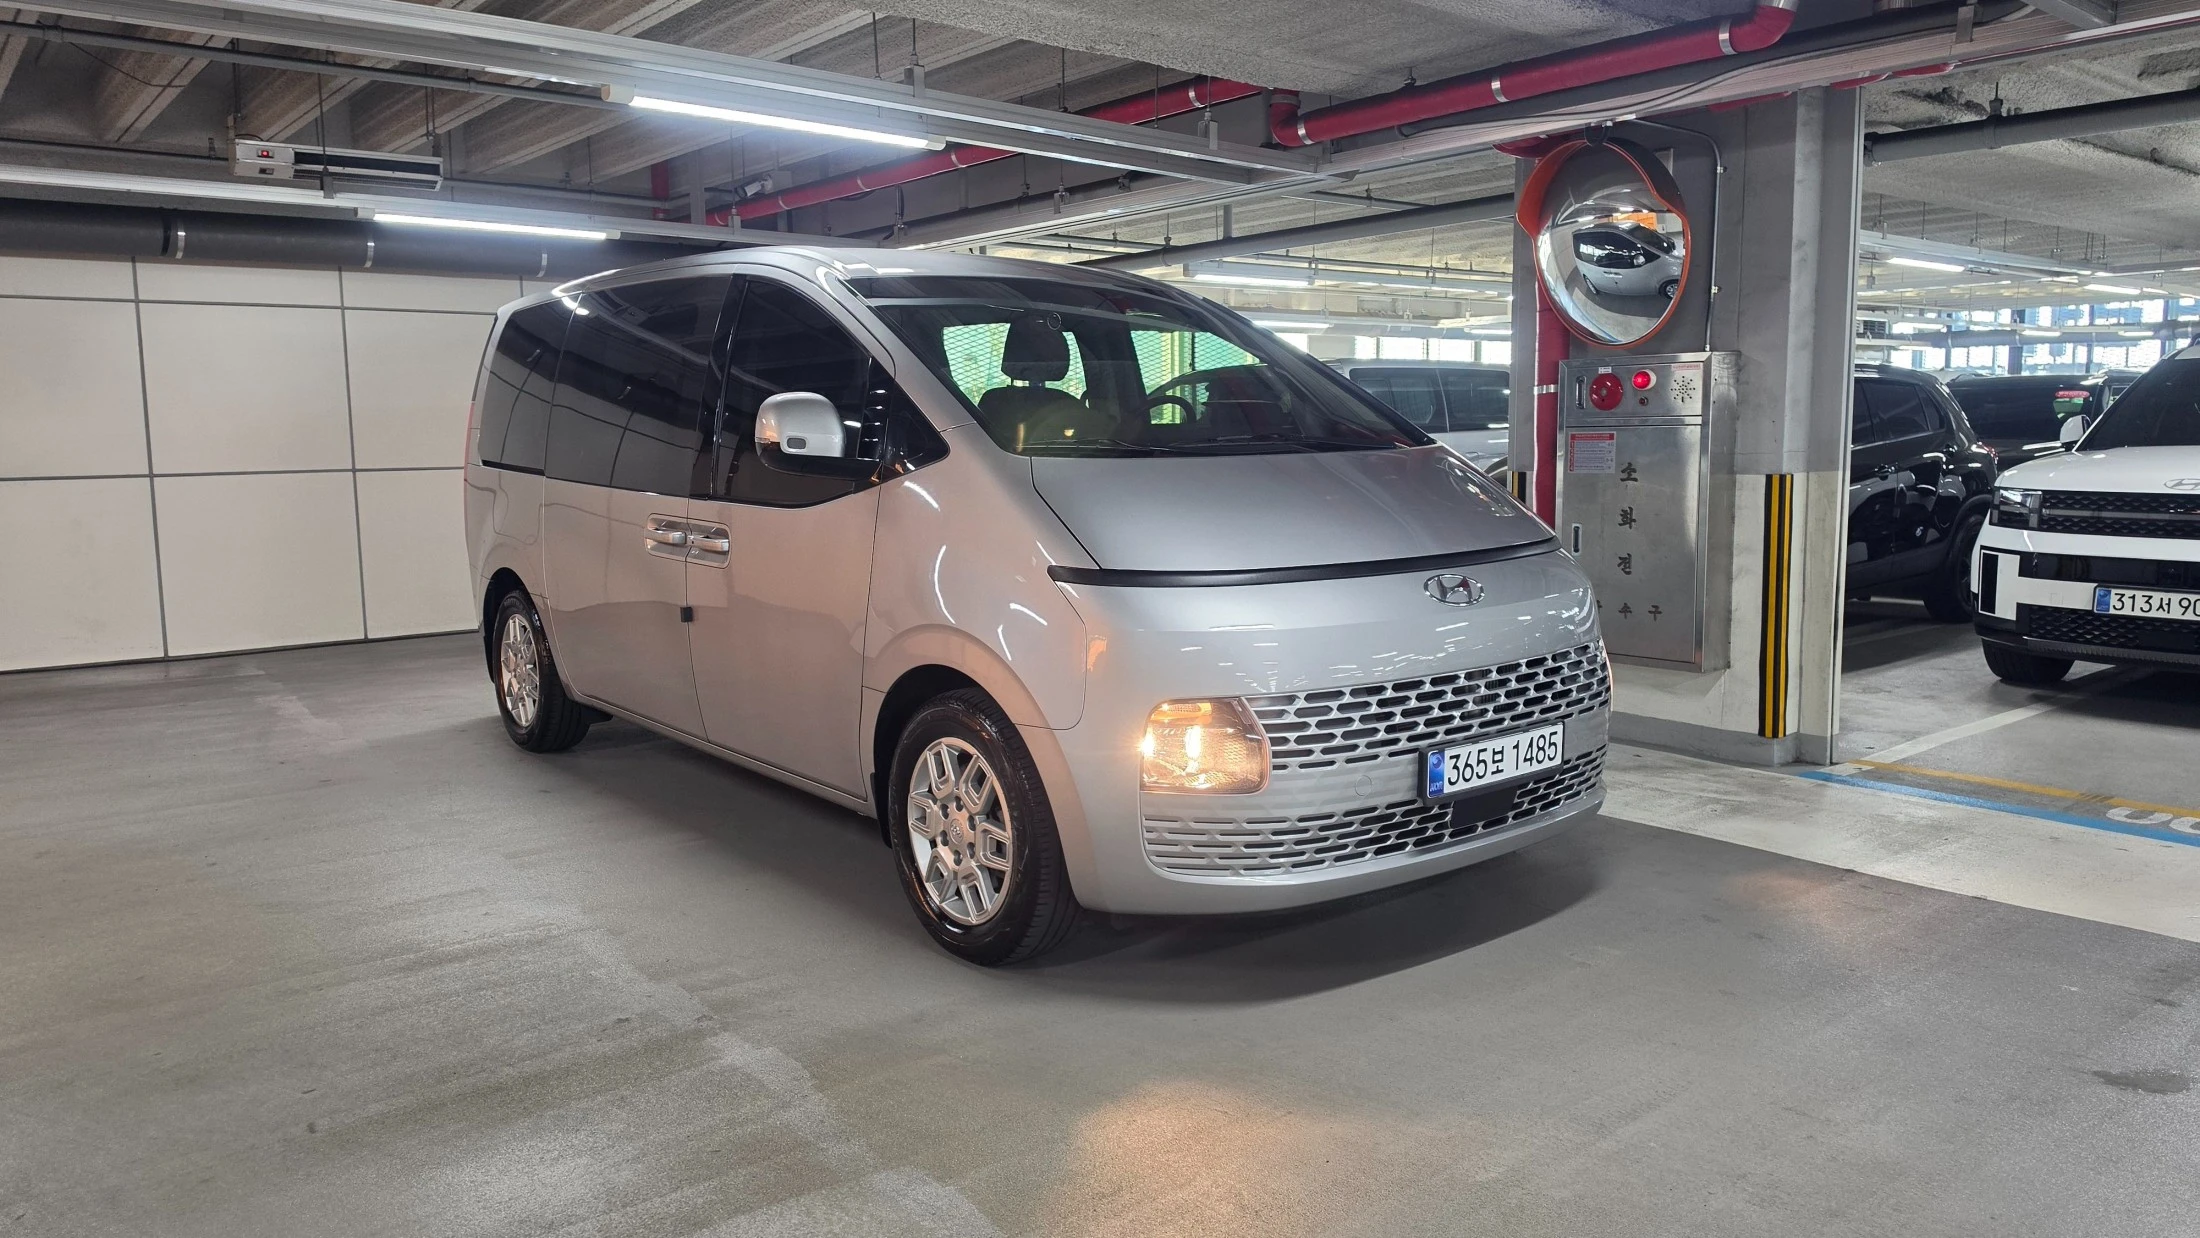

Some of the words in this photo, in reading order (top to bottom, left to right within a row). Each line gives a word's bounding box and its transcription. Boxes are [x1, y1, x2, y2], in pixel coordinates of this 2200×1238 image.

[2112, 592, 2172, 615] 313서
[1447, 745, 1505, 786] 365보
[1512, 730, 1558, 771] 1485
